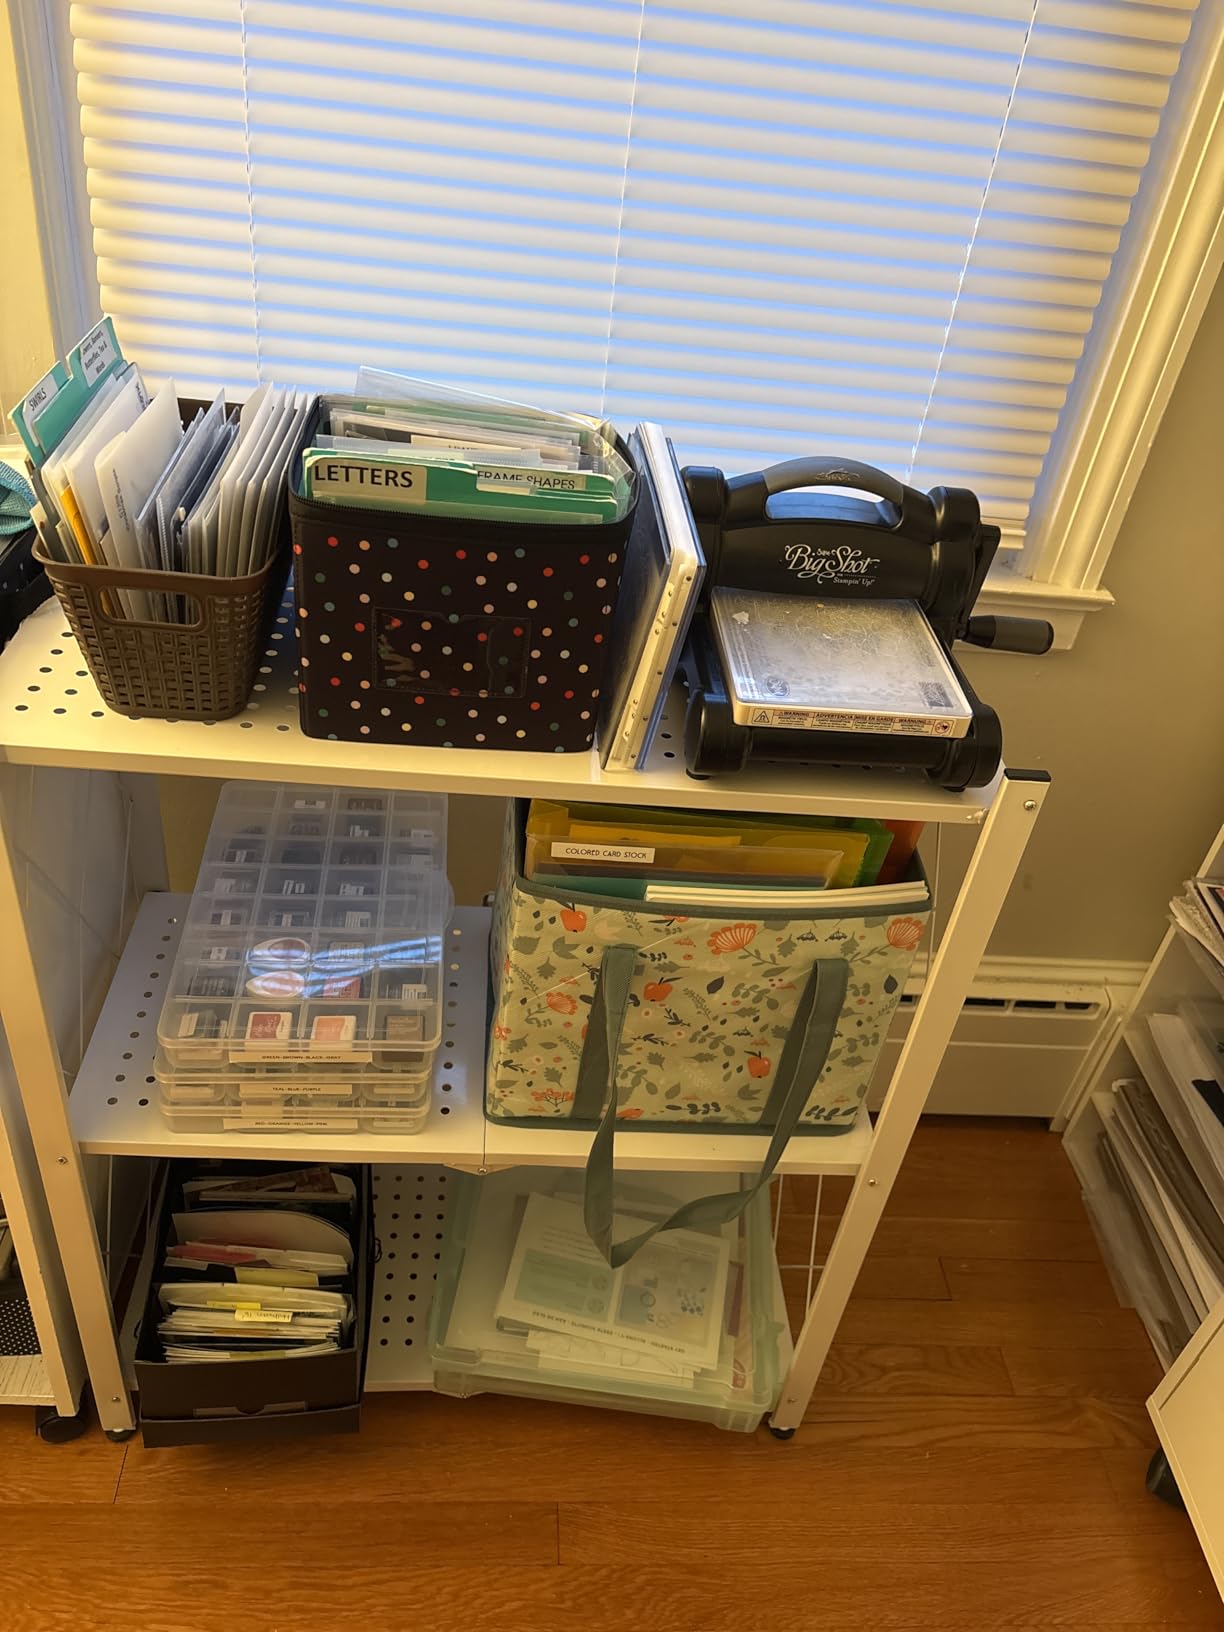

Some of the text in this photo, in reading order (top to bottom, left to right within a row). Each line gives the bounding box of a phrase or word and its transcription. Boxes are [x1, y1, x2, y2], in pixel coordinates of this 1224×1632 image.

[28, 387, 48, 411] SWIRLS
[314, 464, 413, 488] LETTERS
[477, 470, 575, 490] FRAME SHAPES
[785, 544, 880, 584] Big Shot
[833, 577, 861, 587] Stampin'
[565, 847, 600, 856] COLORED
[602, 850, 622, 858] CARD
